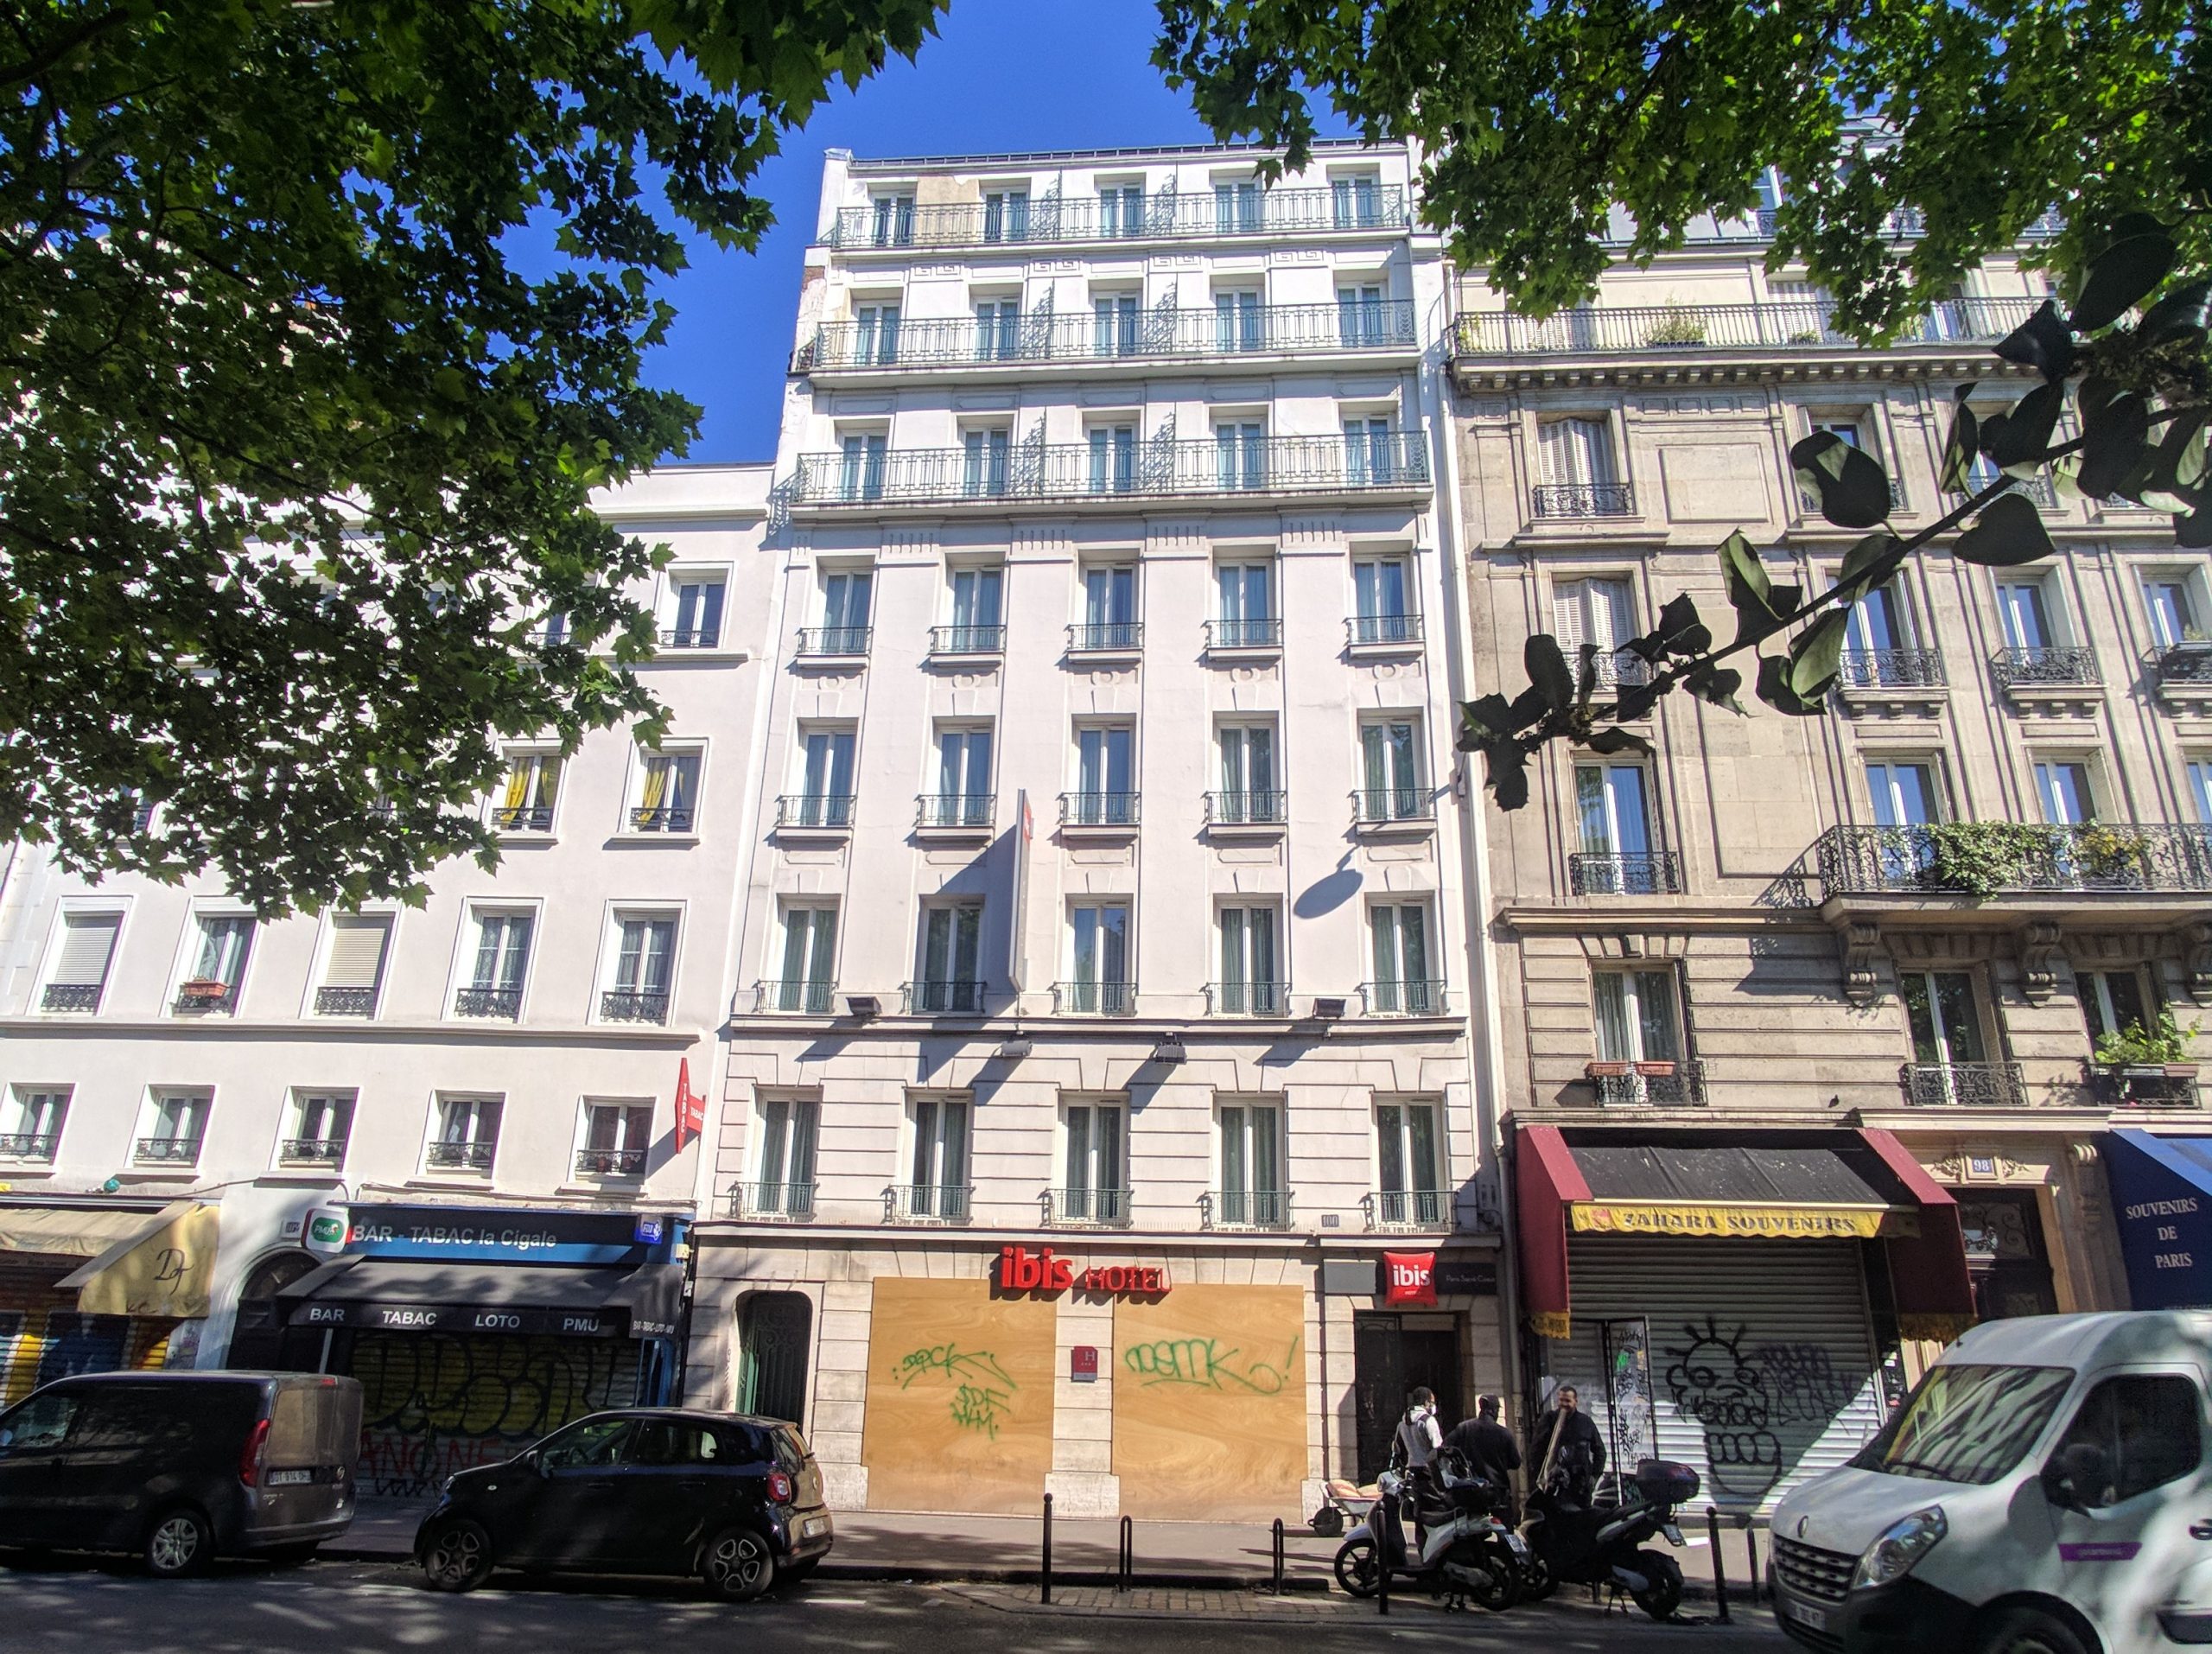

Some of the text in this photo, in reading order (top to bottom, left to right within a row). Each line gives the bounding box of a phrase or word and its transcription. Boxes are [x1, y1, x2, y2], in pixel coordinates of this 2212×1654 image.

[1974, 1159, 1990, 1172] 98
[2126, 1197, 2198, 1219] SOUVENIRS
[1323, 1215, 1338, 1227] 100
[351, 1225, 393, 1243] BAR
[410, 1225, 474, 1244] TABAC
[479, 1229, 495, 1245] la
[500, 1229, 557, 1250] Cigale
[2157, 1225, 2177, 1241] DE
[2154, 1252, 2193, 1269] PARIS
[1001, 1246, 1173, 1292] ibis HOTEL
[1392, 1264, 1431, 1287] ibis
[309, 1307, 345, 1321] BAR
[382, 1310, 437, 1325] TABAC
[475, 1314, 520, 1328] LOTO
[563, 1317, 600, 1332] PMU
[1084, 1351, 1096, 1361] H
